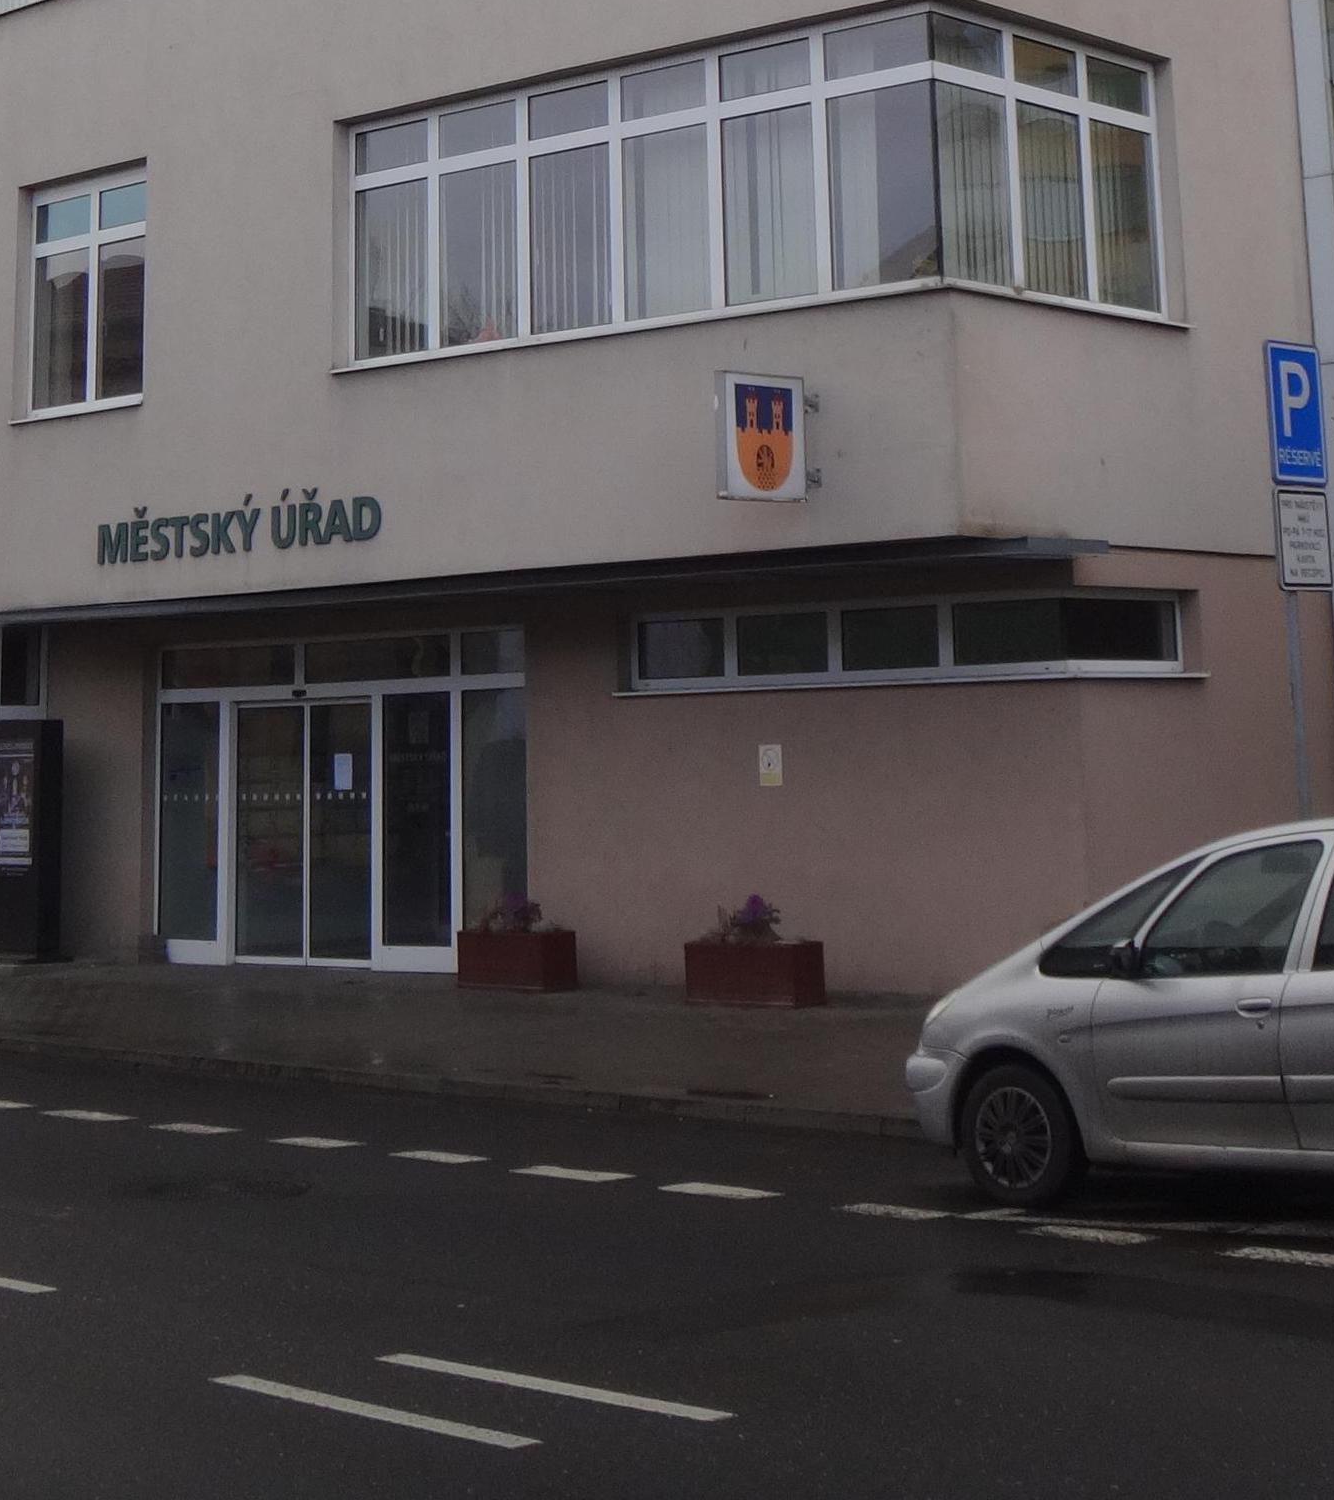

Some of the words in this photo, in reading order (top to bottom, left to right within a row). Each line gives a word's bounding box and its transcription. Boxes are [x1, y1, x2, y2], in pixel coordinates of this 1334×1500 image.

[1278, 360, 1310, 438] P
[97, 493, 261, 565] MĚSTSKÝ
[271, 487, 382, 550] ÚŘAD
